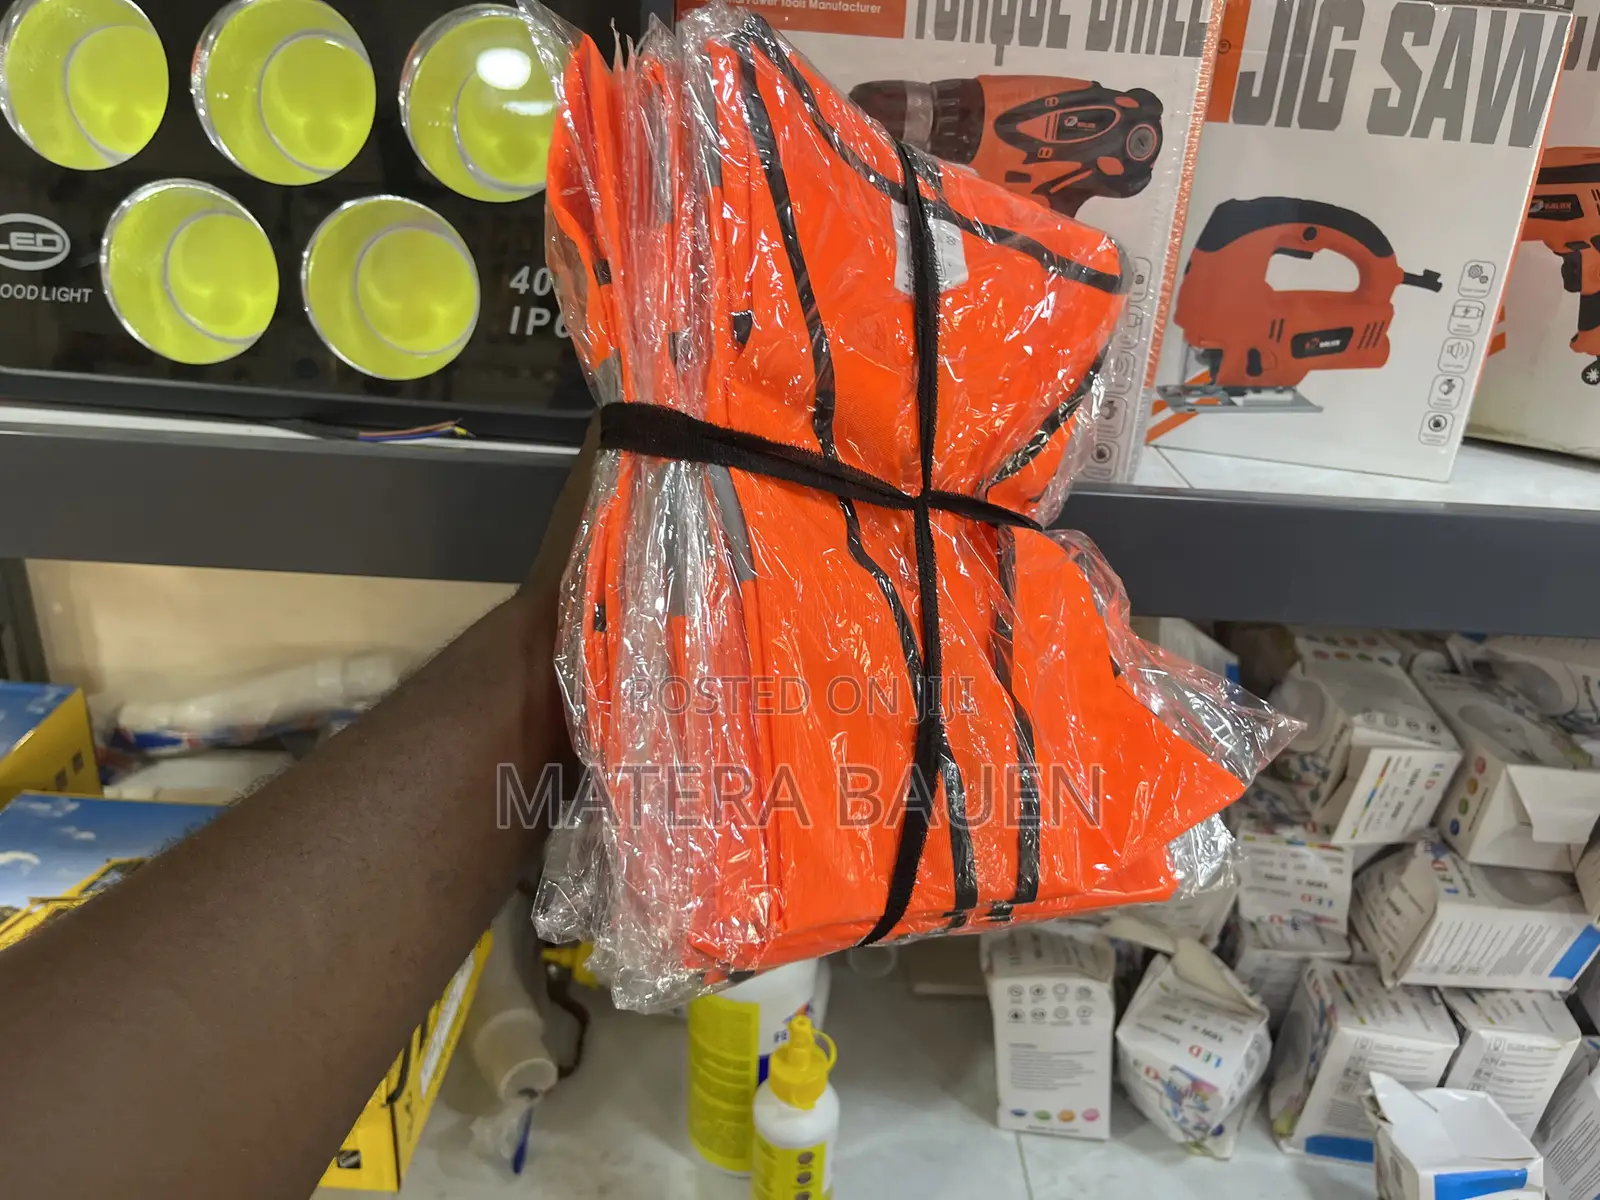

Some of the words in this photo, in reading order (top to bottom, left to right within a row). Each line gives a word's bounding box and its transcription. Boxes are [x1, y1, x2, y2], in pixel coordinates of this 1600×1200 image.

[808, 1, 881, 14] Manufacturer
[1232, 0, 1365, 132] JIG
[1366, 1, 1573, 149] SAW
[41, 286, 93, 303] LIGHT
